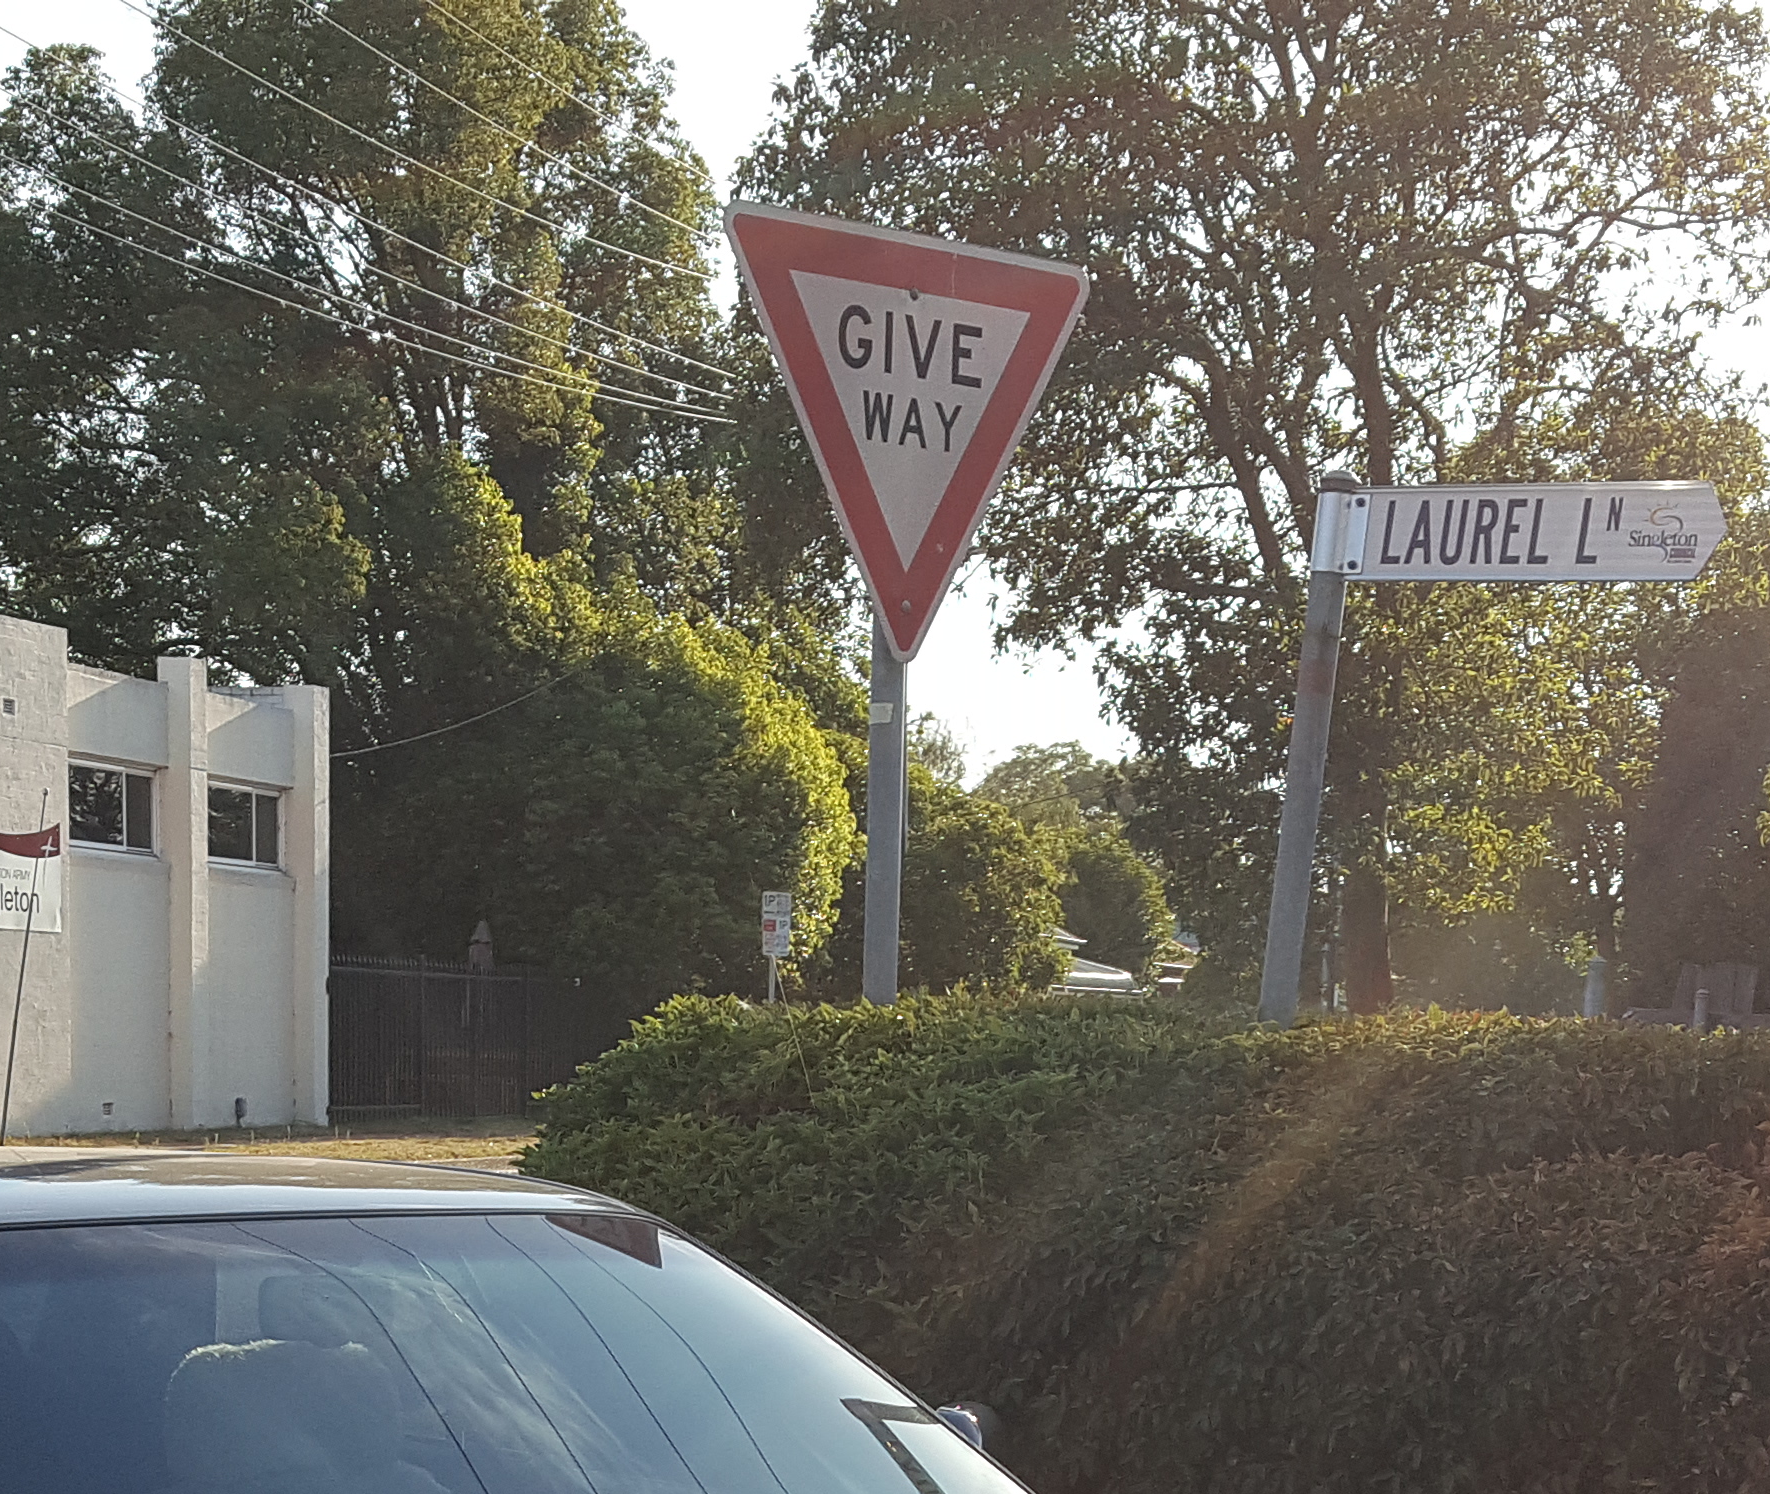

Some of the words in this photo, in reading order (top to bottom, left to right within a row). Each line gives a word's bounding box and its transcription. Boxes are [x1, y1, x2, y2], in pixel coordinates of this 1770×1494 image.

[838, 305, 983, 389] GIVE
[863, 390, 962, 452] WAY
[1380, 498, 1549, 566] LAUREL
[1628, 530, 1698, 556] Singleton
